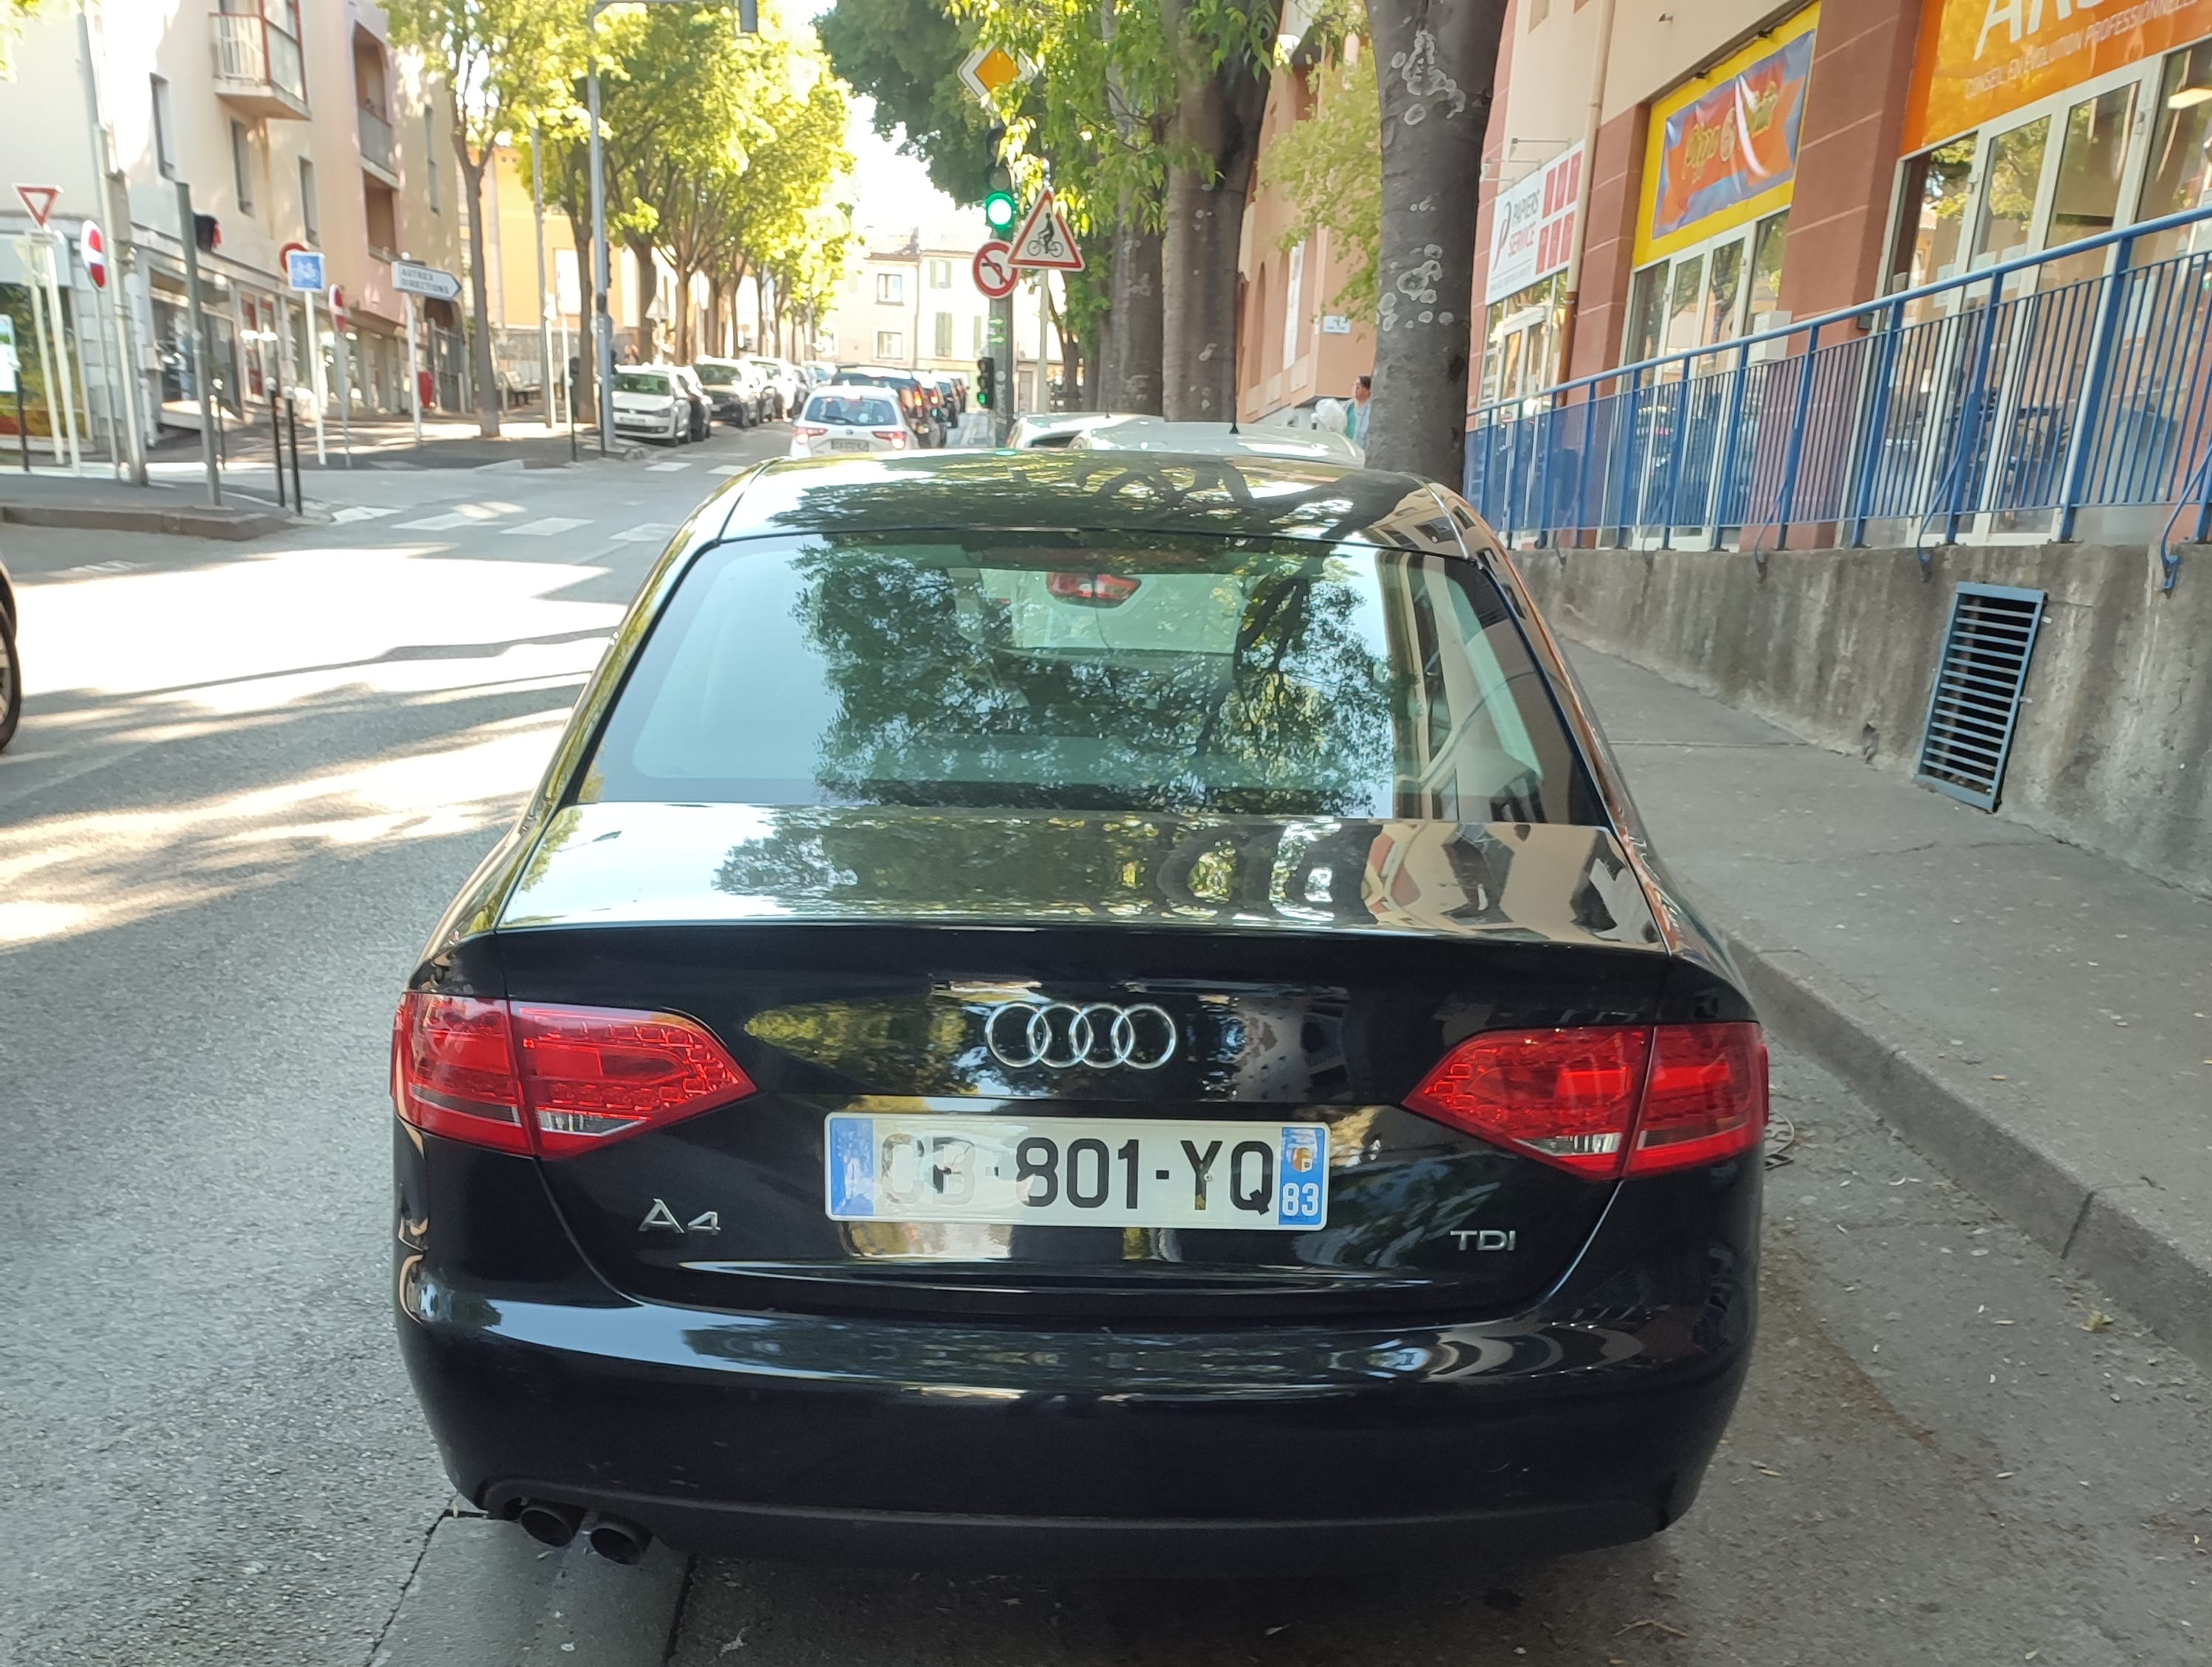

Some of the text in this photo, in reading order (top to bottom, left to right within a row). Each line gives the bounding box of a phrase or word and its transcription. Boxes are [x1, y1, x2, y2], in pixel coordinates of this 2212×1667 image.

[638, 1198, 721, 1236] A4
[1282, 1183, 1319, 1217] 83
[1450, 1230, 1516, 1250] TDI
